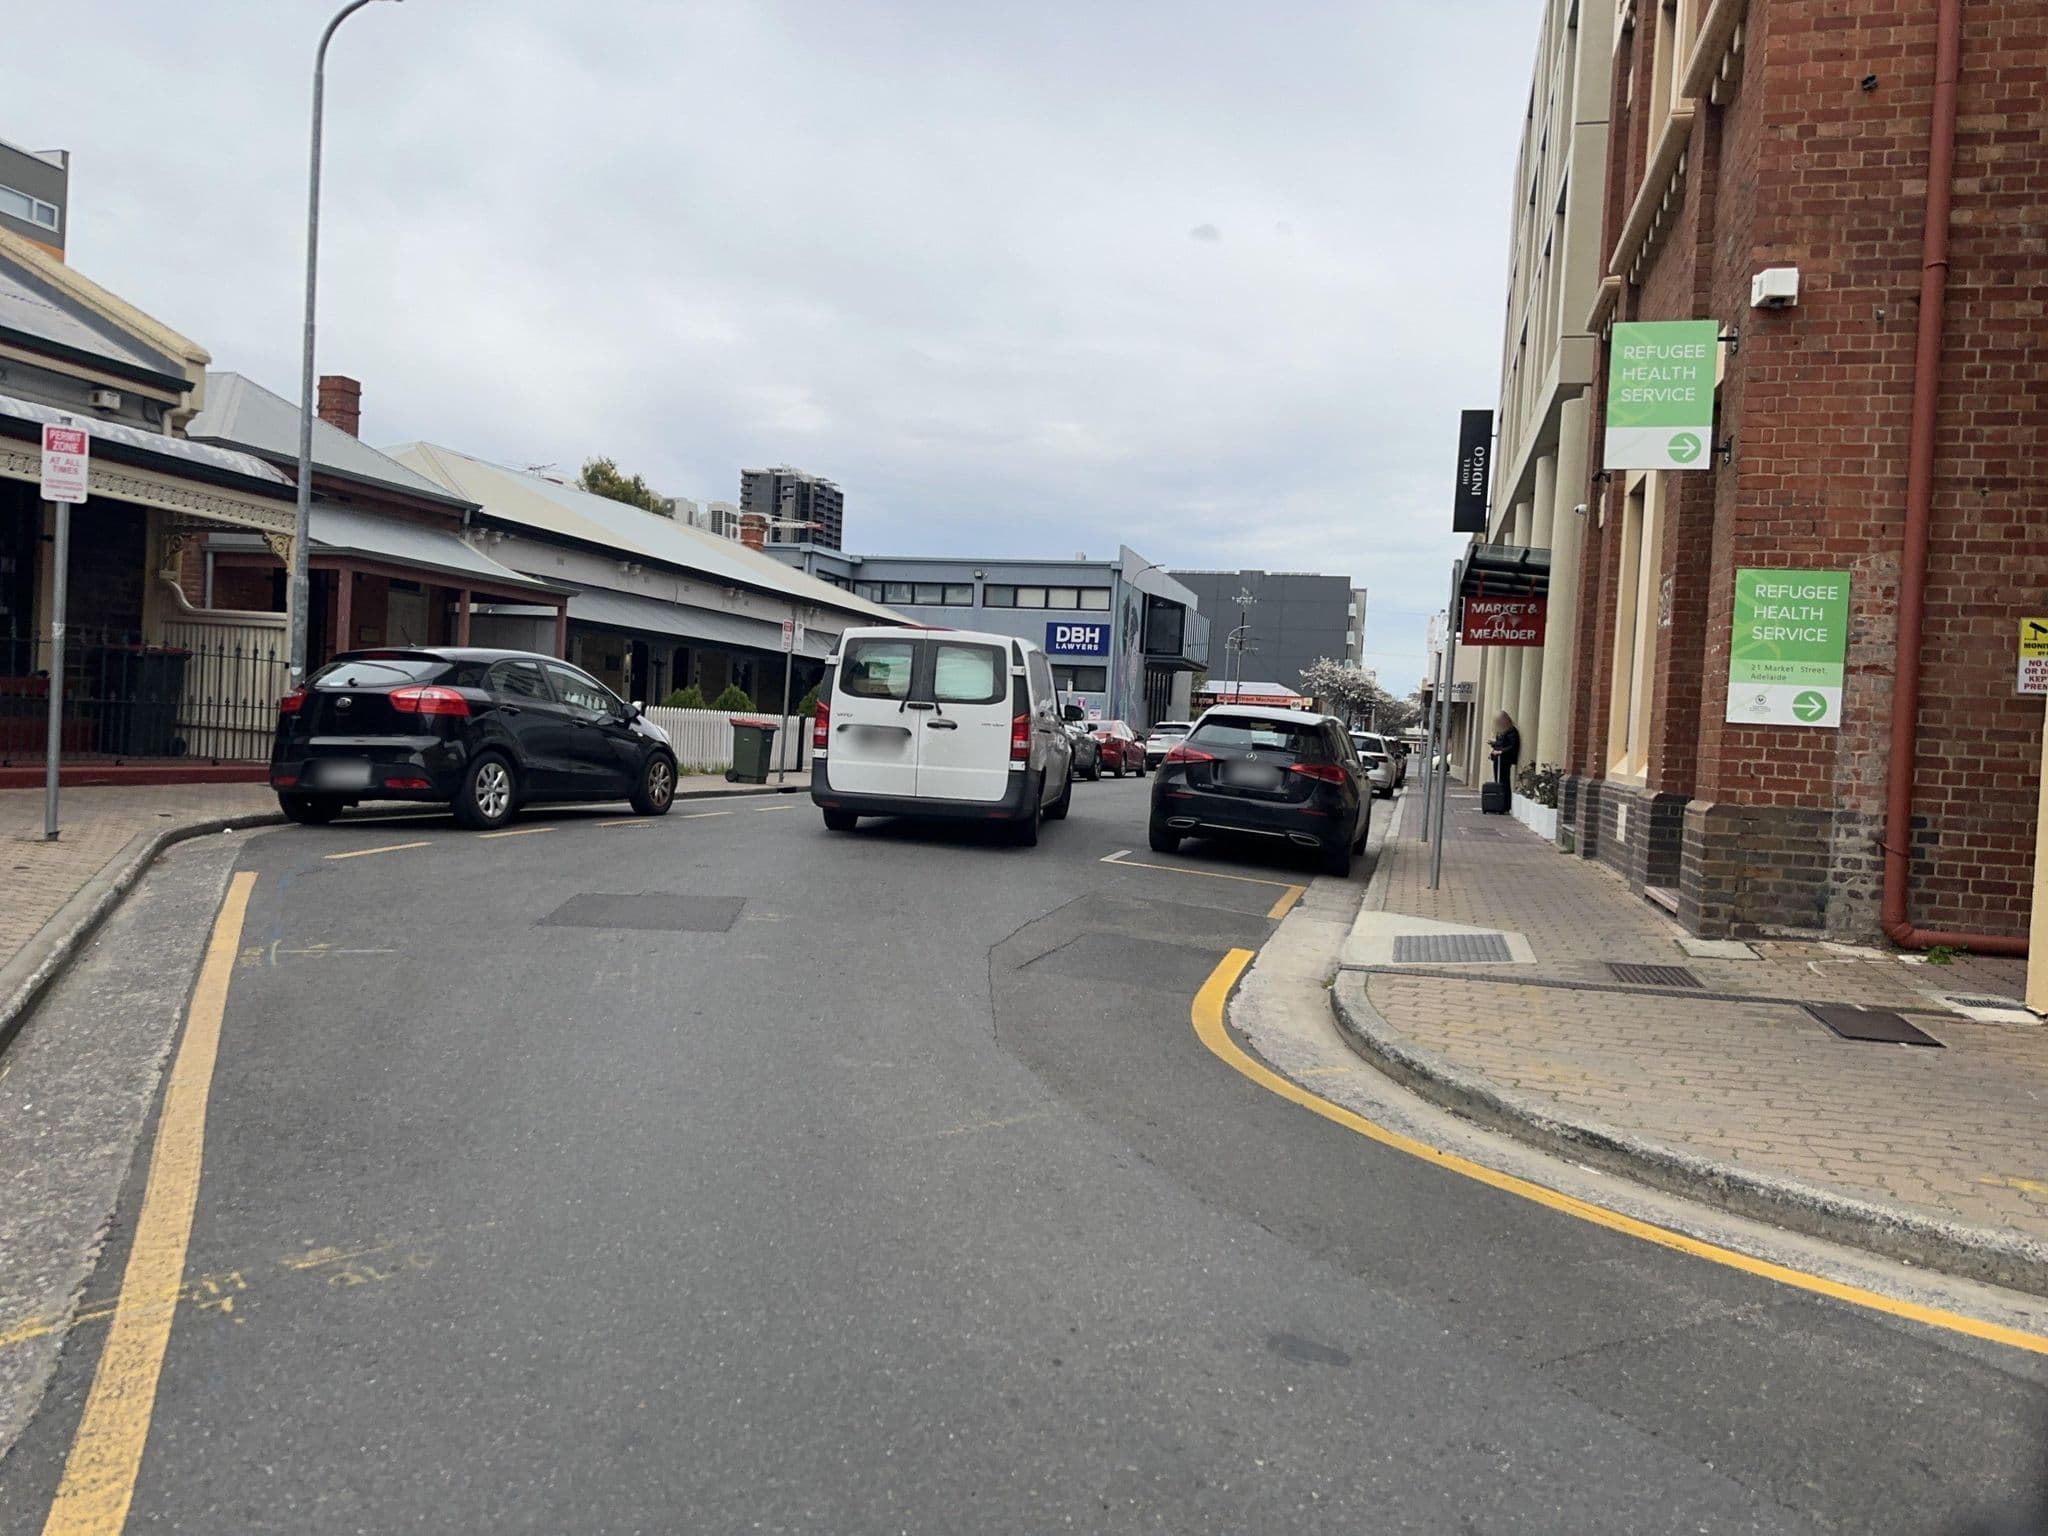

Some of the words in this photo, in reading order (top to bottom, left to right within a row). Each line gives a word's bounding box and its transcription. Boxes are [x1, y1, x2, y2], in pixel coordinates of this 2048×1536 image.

[1623, 344, 1706, 360] REFUGEE
[1622, 366, 1697, 381] HEALTH
[1621, 387, 1696, 402] SERVICE
[49, 429, 82, 442] PERMIT
[52, 441, 80, 453] ZONE
[49, 456, 61, 465] AT
[65, 458, 80, 468] ALL
[53, 465, 80, 475] TIMES
[1462, 457, 1471, 485] HOTEL
[1471, 446, 1486, 496] INDIGO
[1755, 584, 1838, 600] REFUGEE
[1471, 603, 1527, 614] MARKET
[1527, 603, 1538, 615] &
[1753, 605, 1824, 621] HEALTH
[1056, 626, 1100, 643] DBH
[1470, 628, 1537, 640] MEANDER
[1752, 626, 1828, 642] SERVICE
[1055, 643, 1100, 651] LAWYERS
[1764, 664, 1794, 672] Market
[2024, 667, 2038, 675] OR
[1750, 673, 1787, 681] Adelaide
